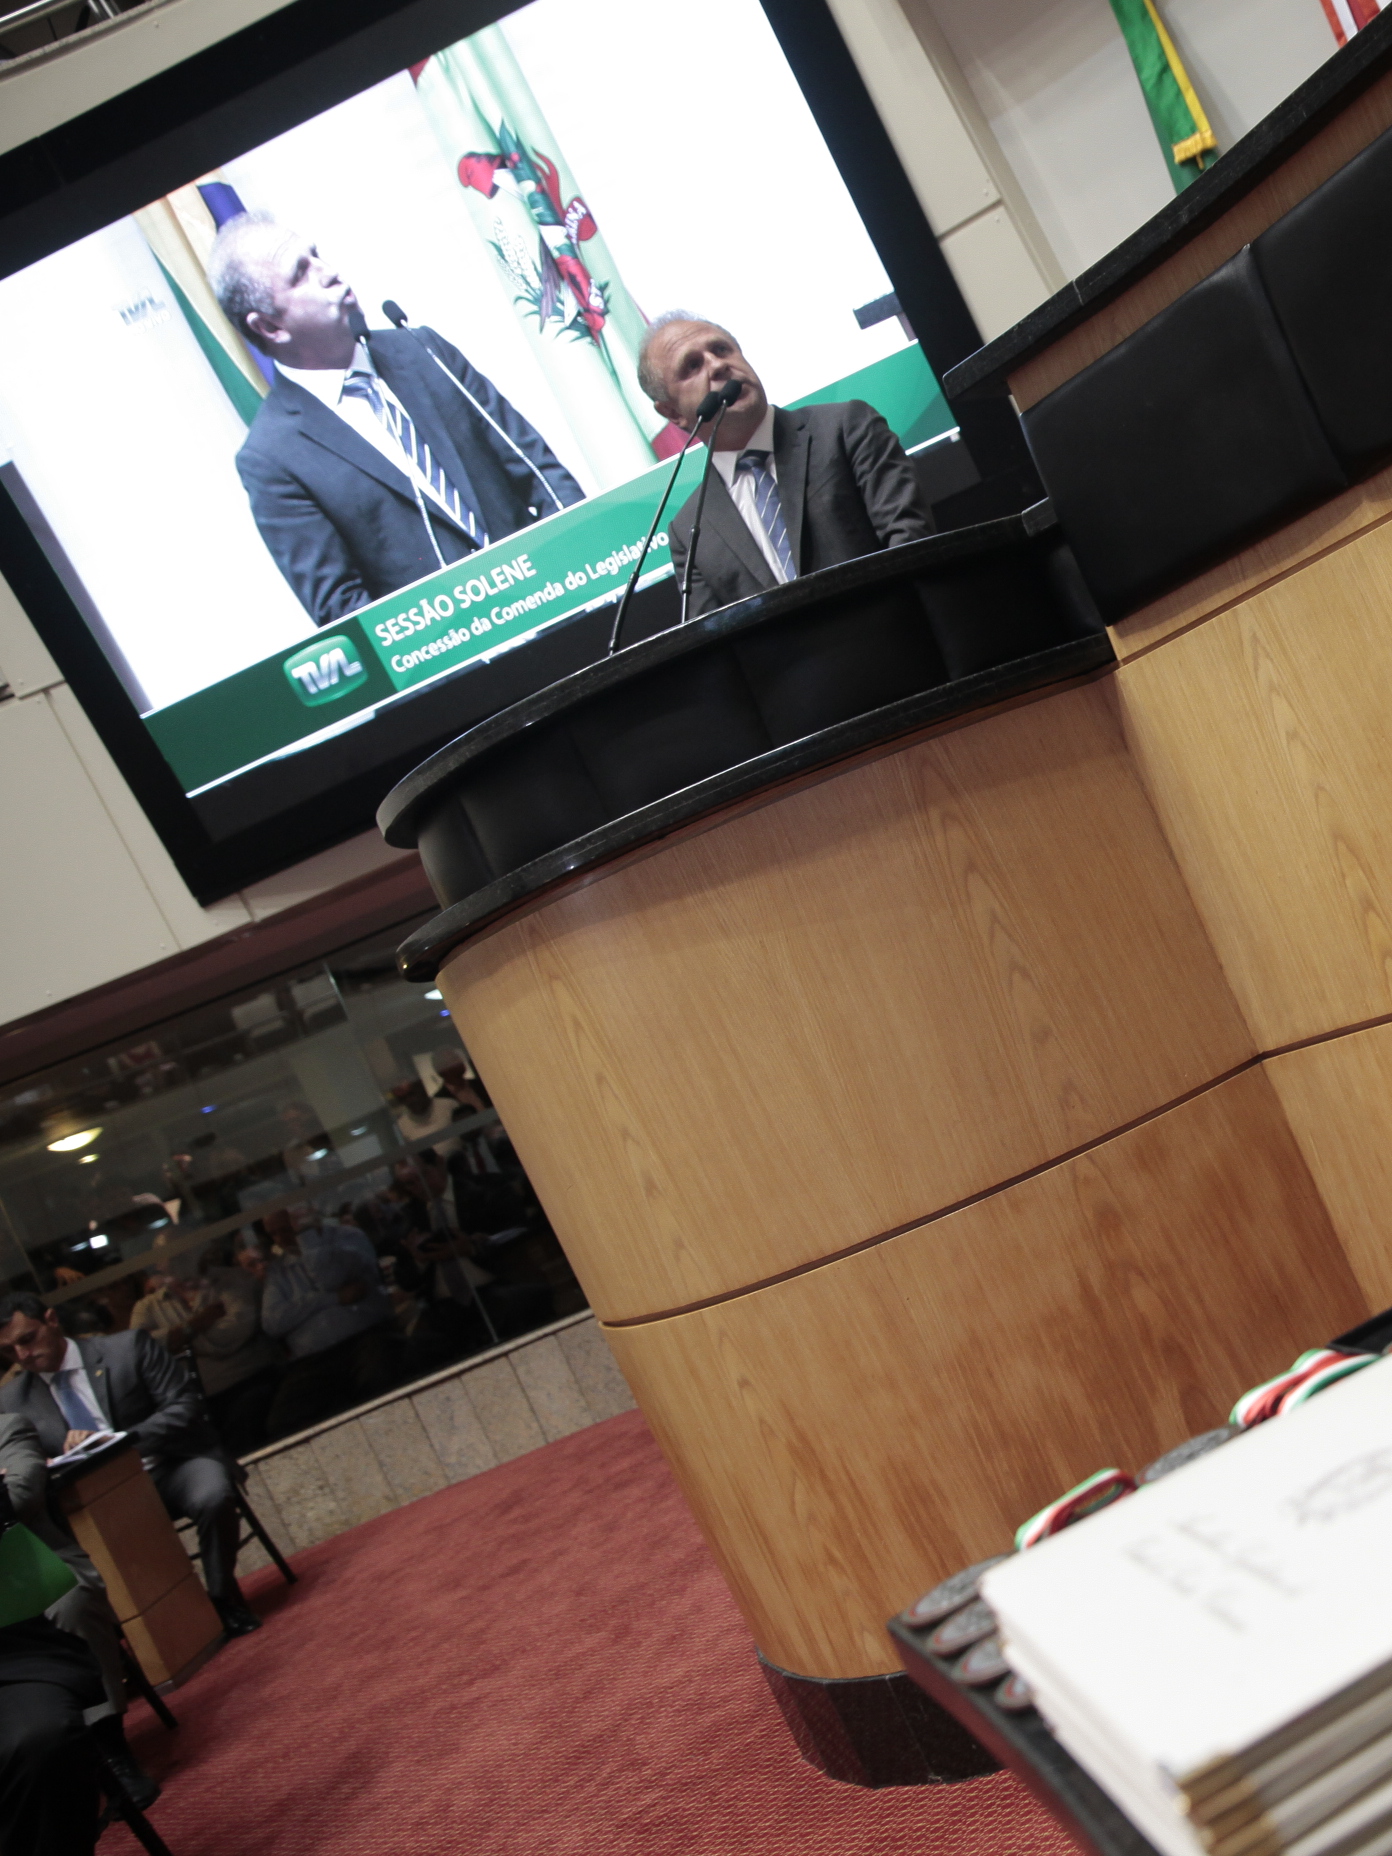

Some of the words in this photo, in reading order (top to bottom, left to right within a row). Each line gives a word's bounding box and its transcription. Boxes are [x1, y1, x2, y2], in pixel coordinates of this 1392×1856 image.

[374, 594, 454, 647] SESSÃO
[453, 553, 537, 609] SOLENE
[390, 627, 471, 673] Concessão
[470, 616, 492, 636] da
[490, 581, 565, 625] Comenda
[564, 570, 588, 591] do
